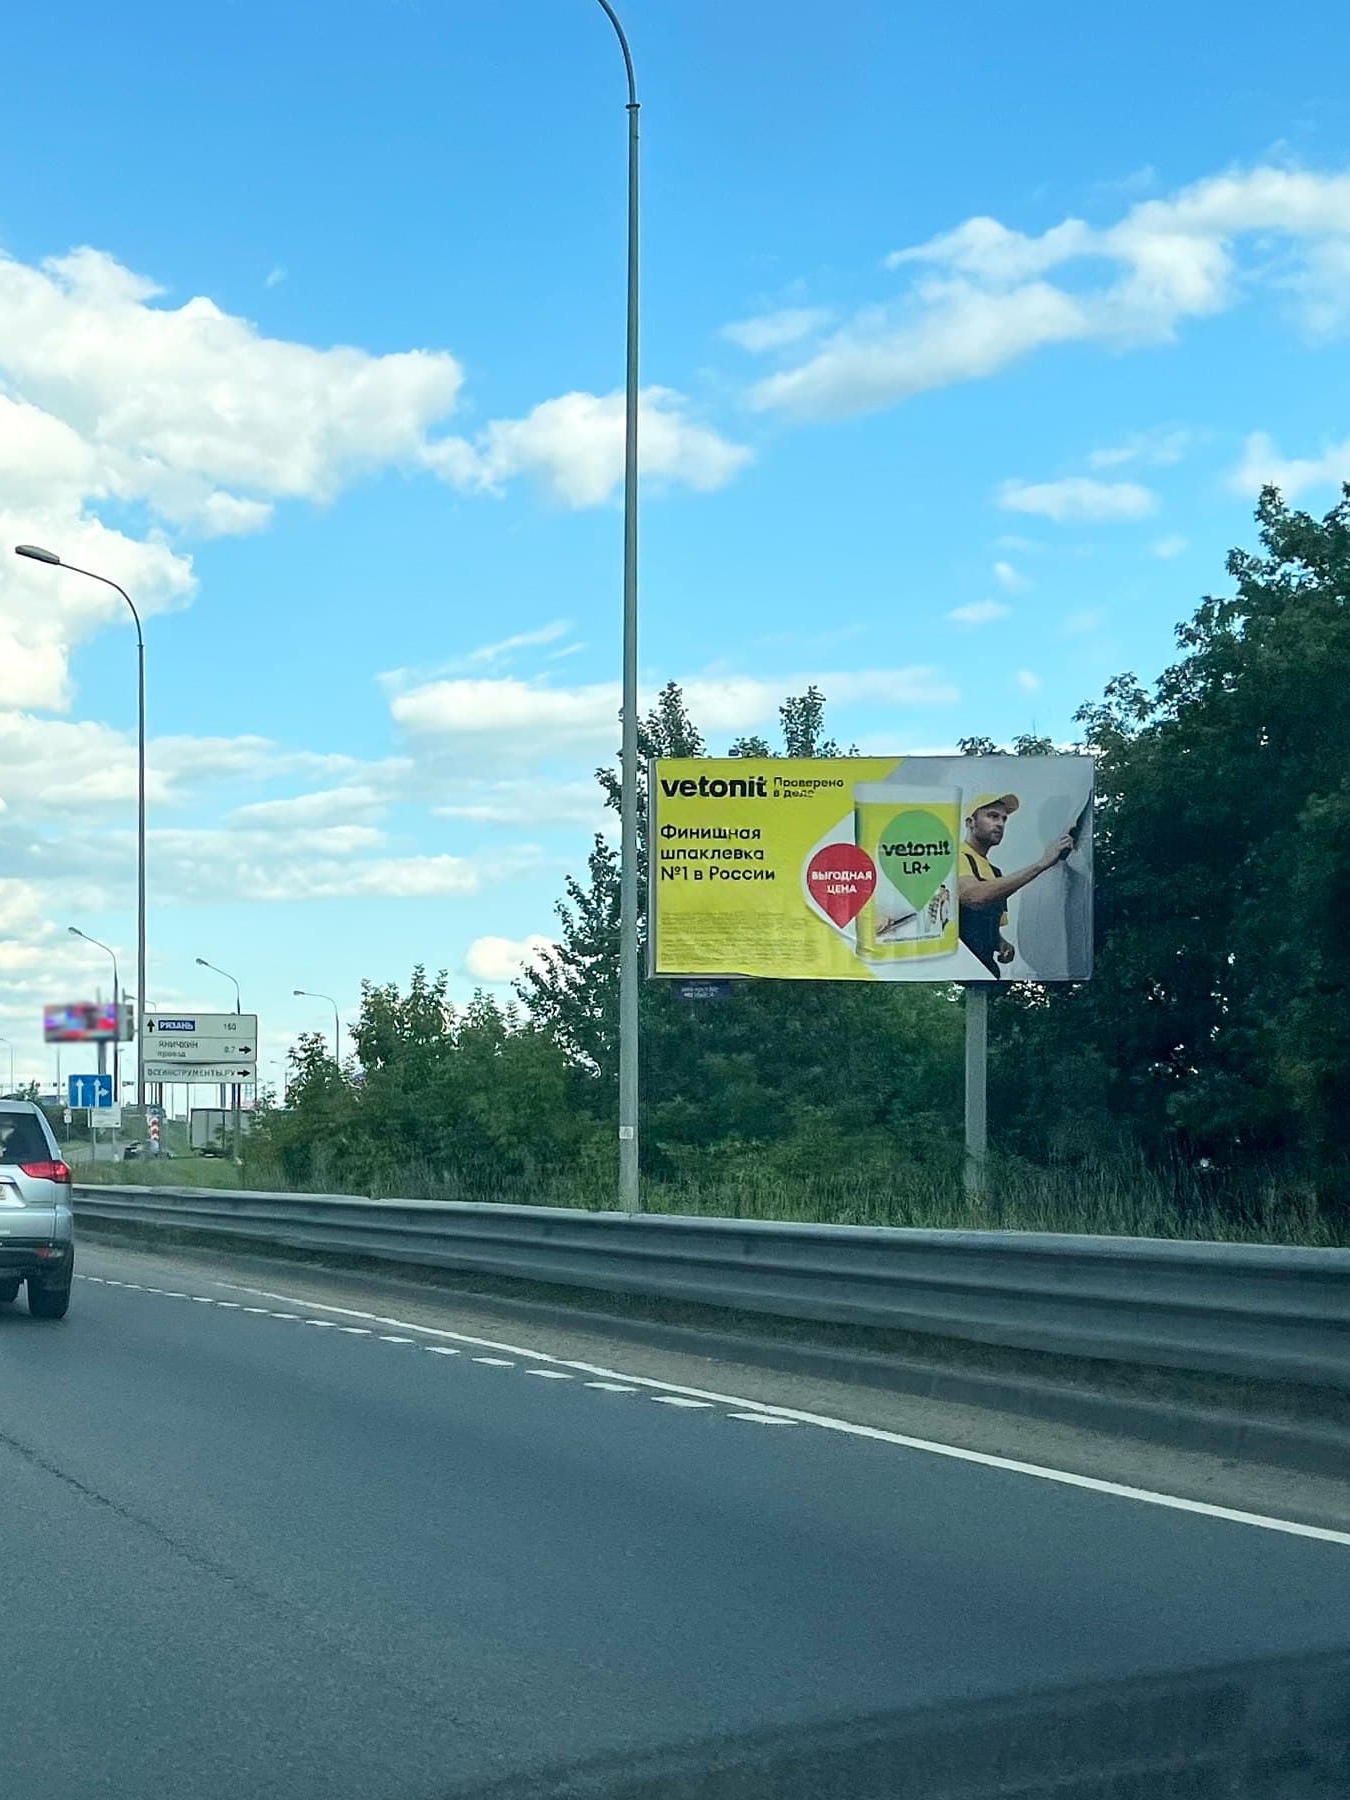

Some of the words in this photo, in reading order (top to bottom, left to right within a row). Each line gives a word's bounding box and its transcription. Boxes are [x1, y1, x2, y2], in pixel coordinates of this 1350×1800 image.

[661, 776, 767, 798] vetonit
[773, 776, 844, 789] Проверено
[660, 848, 764, 860] шпаклевка
[882, 840, 951, 857] vetonit
[661, 866, 688, 881] №1
[694, 870, 703, 880] в
[709, 866, 775, 881] России
[903, 861, 931, 874] LR+
[811, 870, 872, 881] ВЫГОДНАЯ
[826, 885, 857, 894] ЦЕНА
[160, 1021, 193, 1030] РЯЗАНЬ
